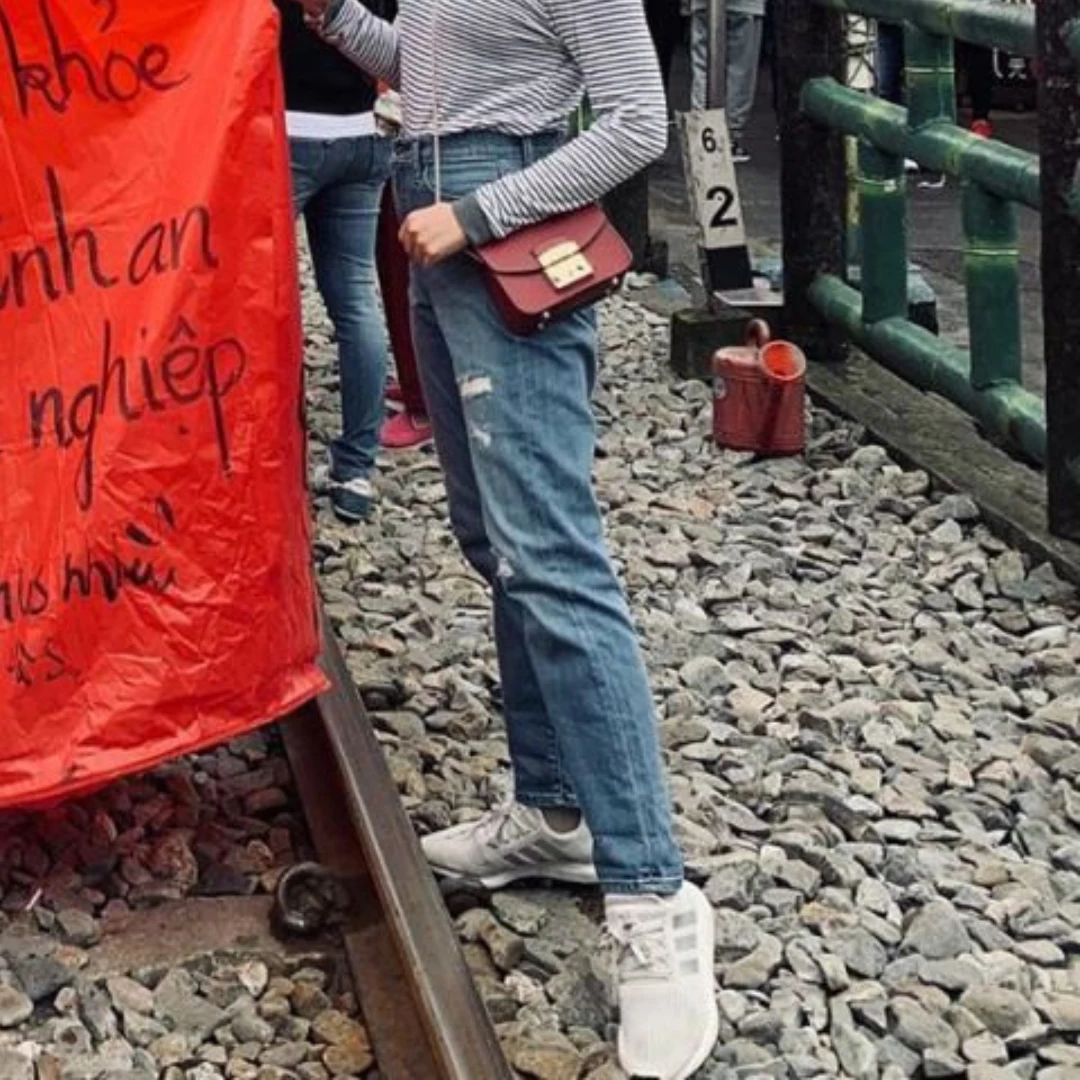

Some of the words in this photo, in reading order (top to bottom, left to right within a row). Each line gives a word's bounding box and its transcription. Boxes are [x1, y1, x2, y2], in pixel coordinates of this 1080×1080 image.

[701, 128, 716, 153] 6
[706, 185, 738, 228] 2
[128, 204, 218, 285] an
[29, 315, 246, 512] nghiệp
